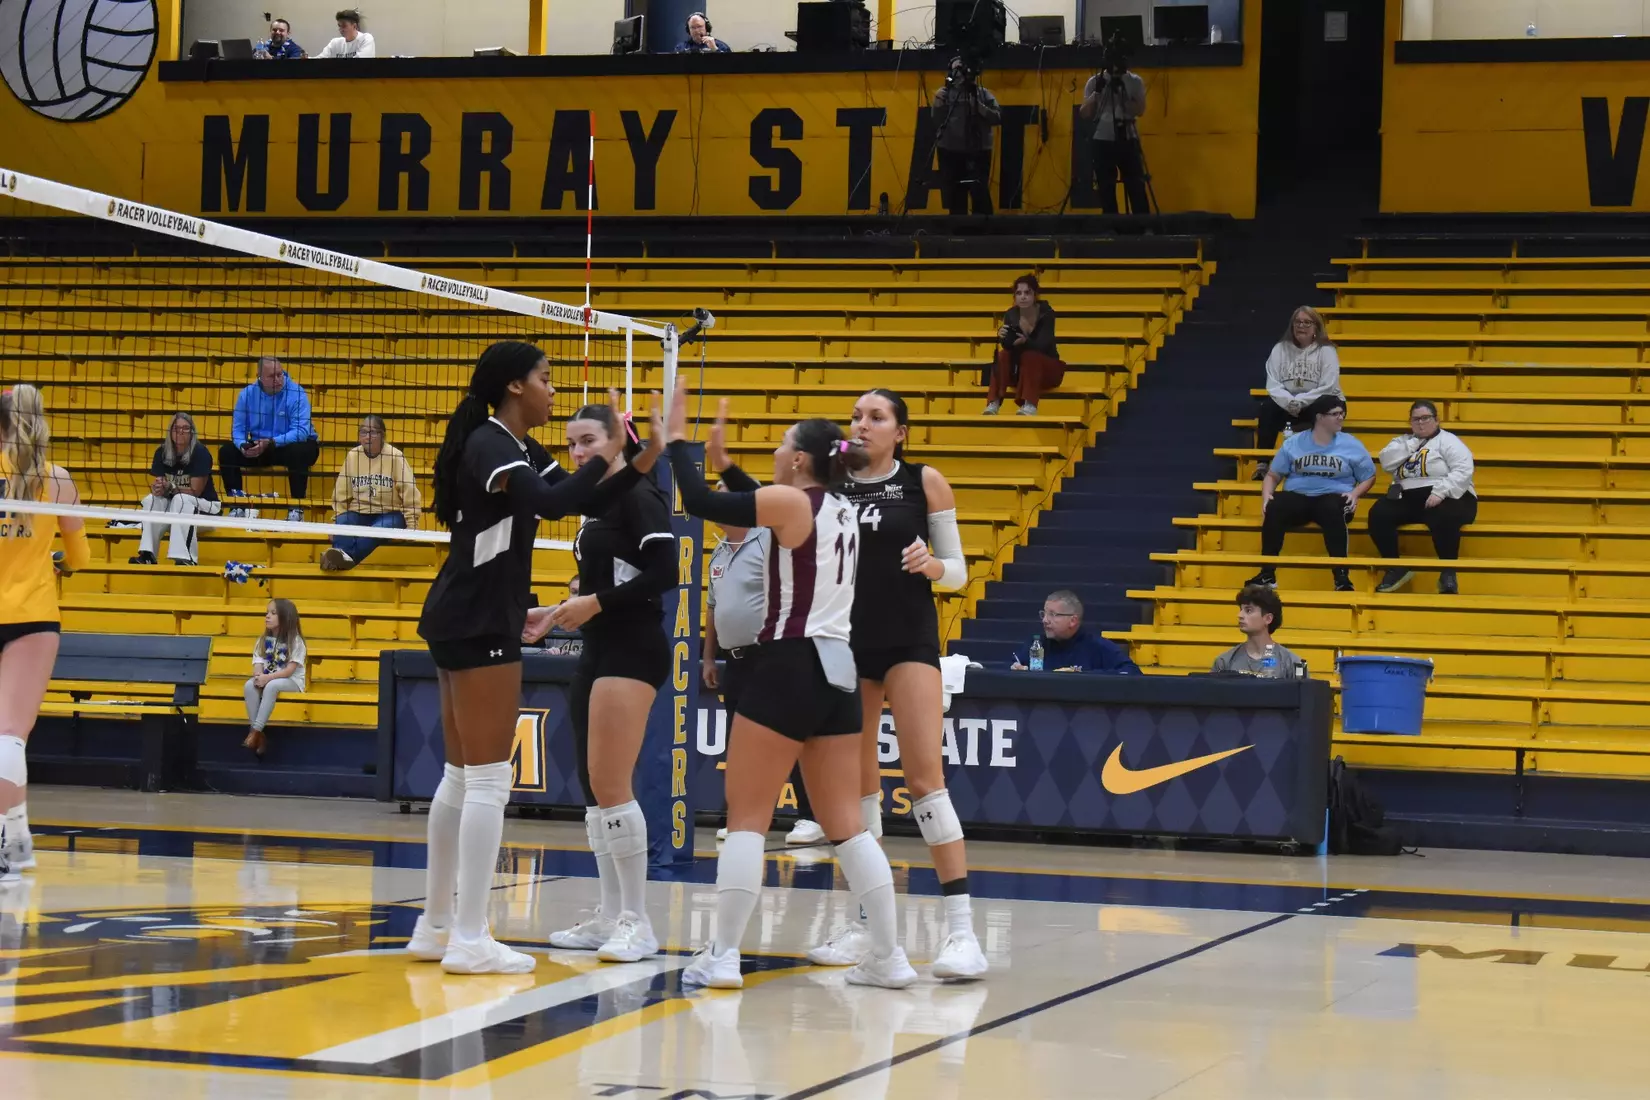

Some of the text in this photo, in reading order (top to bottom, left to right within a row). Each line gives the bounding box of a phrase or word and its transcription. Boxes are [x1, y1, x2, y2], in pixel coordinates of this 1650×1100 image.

[200, 109, 678, 213] MURRAY
[116, 202, 197, 235] RACER VOLLEYBALL
[287, 244, 353, 272] RACER VOLLEYBALL
[427, 277, 484, 301] RACER VOLLEYBALL
[546, 303, 563, 318] RACER
[1294, 453, 1343, 473] MURRAY
[671, 536, 694, 849] RACERS
